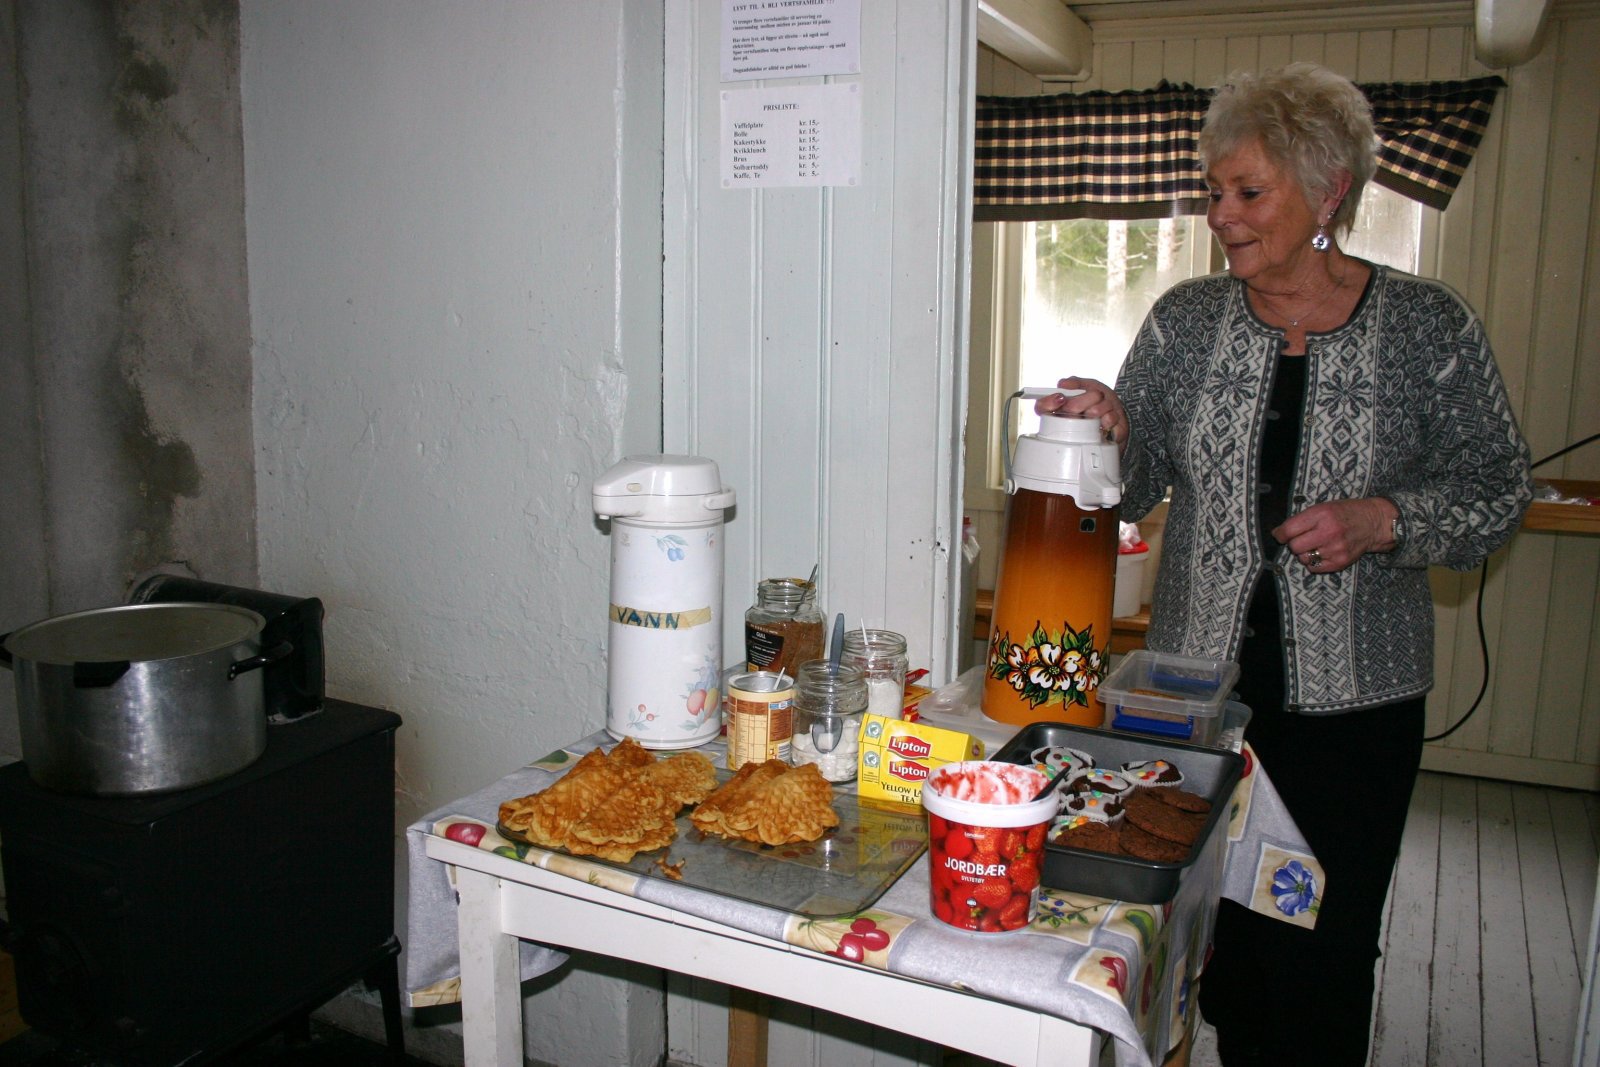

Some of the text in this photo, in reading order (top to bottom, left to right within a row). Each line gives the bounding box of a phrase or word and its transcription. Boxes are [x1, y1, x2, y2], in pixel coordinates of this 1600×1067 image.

[618, 606, 680, 630] VANN
[892, 738, 928, 754] Lipton
[892, 762, 927, 778] Lipton
[881, 782, 912, 795] YELLOW
[901, 794, 915, 803] TEA
[944, 856, 1006, 876] JORDBÆR
[961, 875, 985, 884] SYLTETØY
